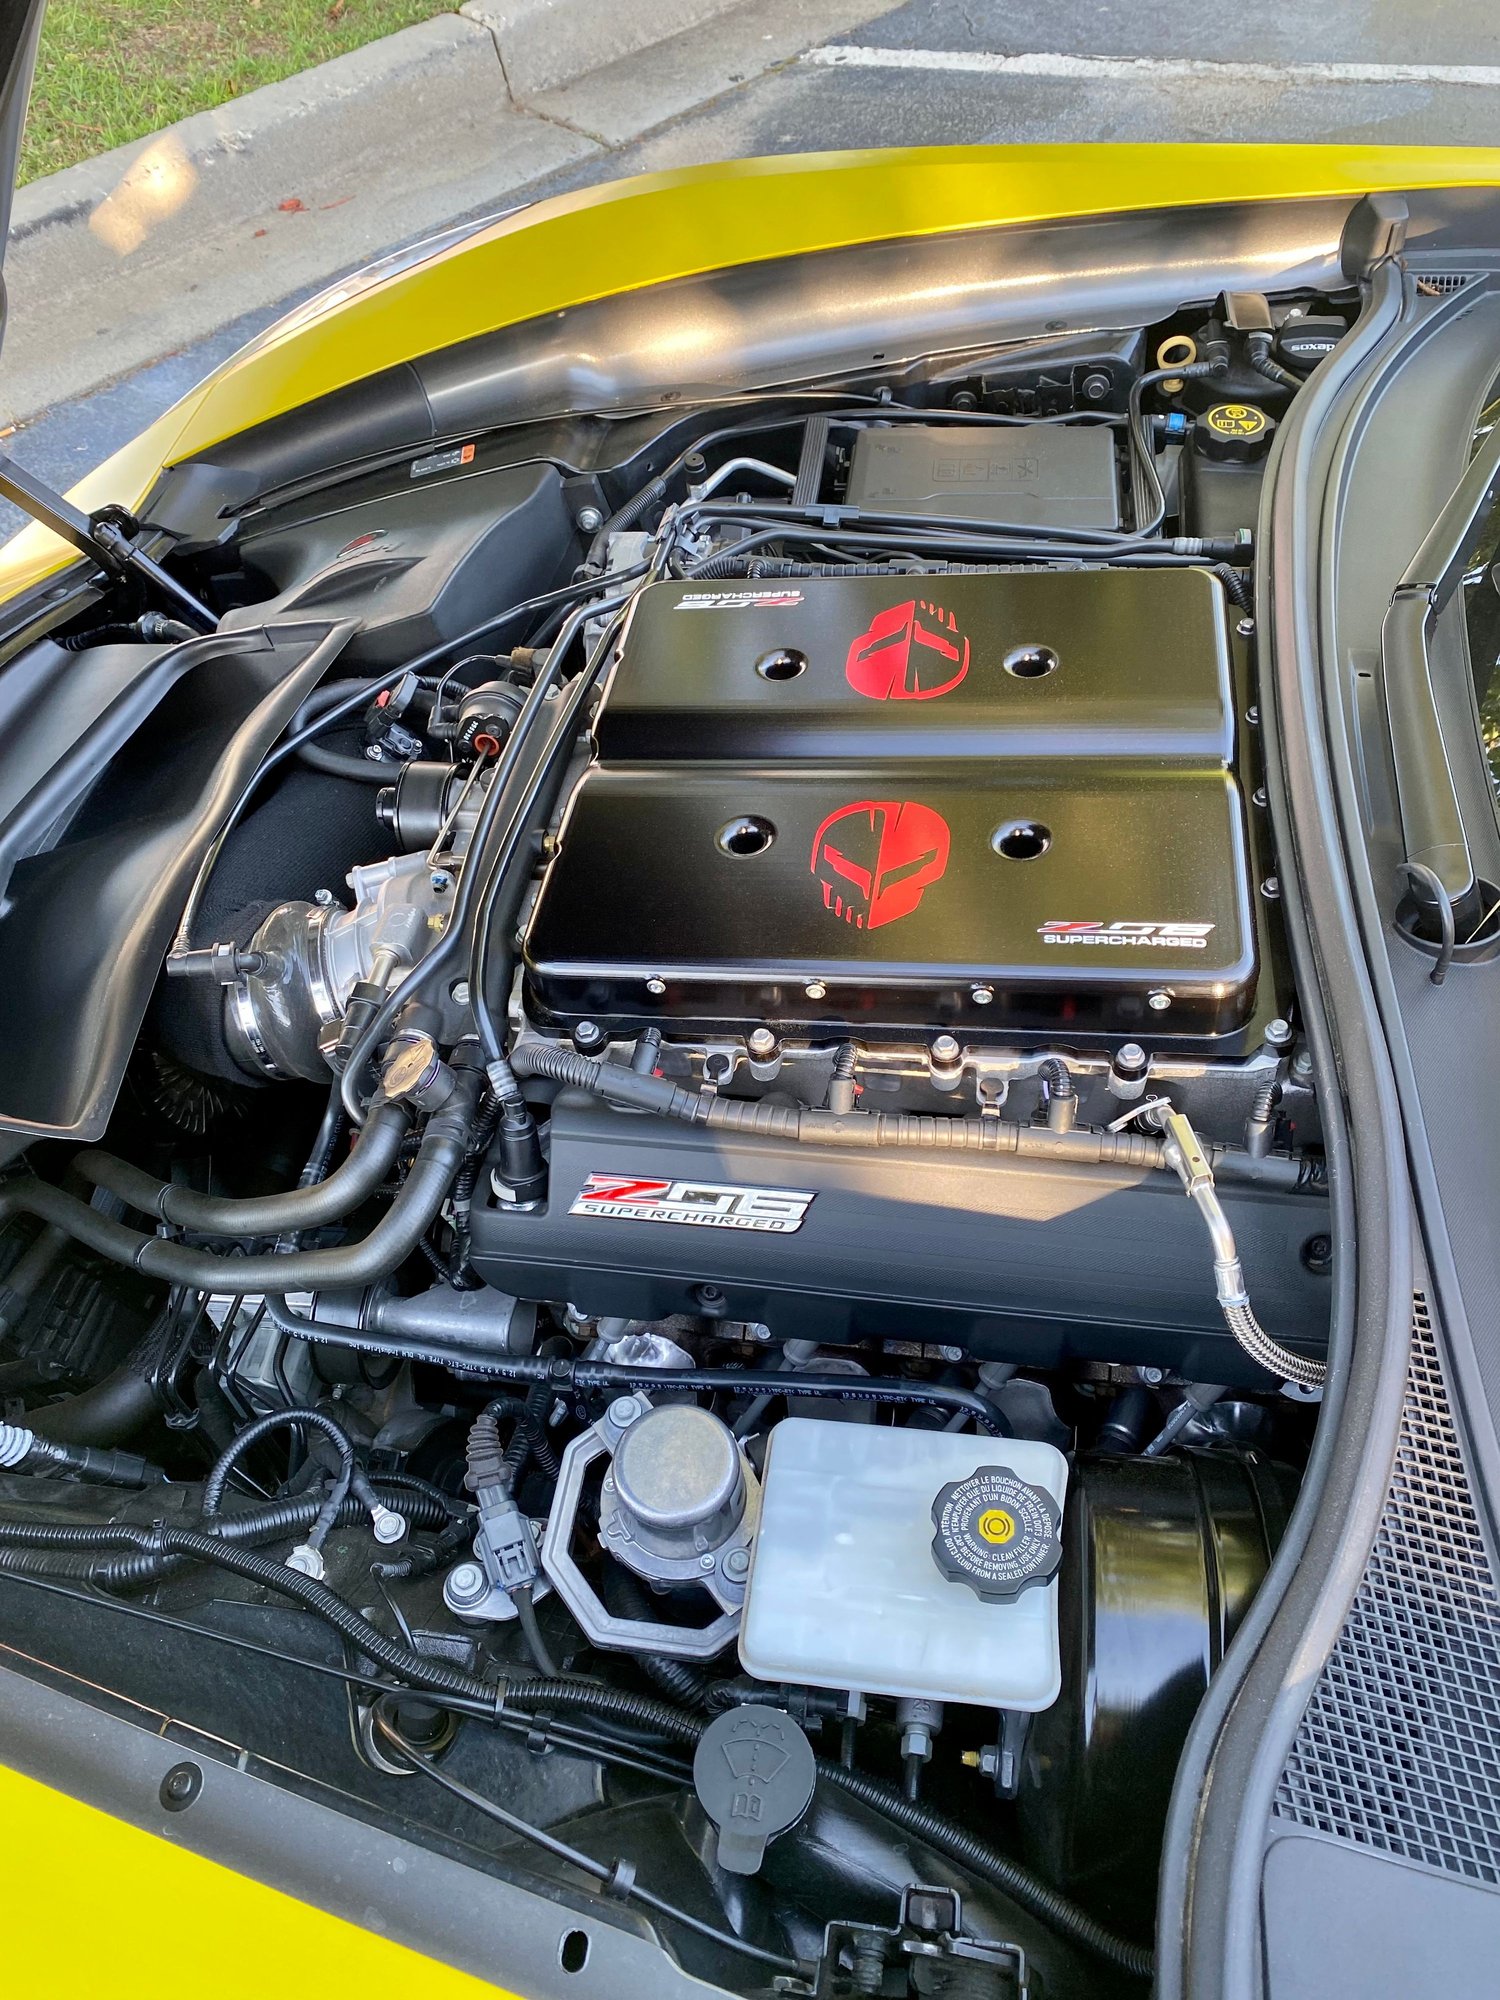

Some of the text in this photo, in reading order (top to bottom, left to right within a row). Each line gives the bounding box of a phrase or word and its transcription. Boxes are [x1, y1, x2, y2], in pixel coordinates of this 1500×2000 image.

[1291, 343, 1336, 352] dexos
[673, 598, 805, 609] Z06
[683, 591, 800, 600] SUPERCHARGED
[1037, 921, 1216, 936] Z06
[1043, 935, 1208, 949] SUPERCHARGED
[580, 1176, 817, 1219] Z06
[584, 1204, 786, 1231] SUPERCHARGED
[941, 1501, 954, 1536] ATTENTION
[950, 1478, 981, 1501] NETTOYER
[980, 1476, 990, 1485] LE
[991, 1475, 1023, 1490] BOUCHON
[1020, 1486, 1041, 1504] AVANT
[1036, 1503, 1047, 1514] LA
[960, 1496, 982, 1531] PROVENANT
[982, 1493, 999, 1502] D'UN
[1000, 1494, 1022, 1510] BIDON
[966, 1487, 981, 1499] QUE
[980, 1484, 990, 1493] DU
[991, 1484, 1018, 1497] LIQUIDE
[1016, 1492, 1027, 1503] DE
[1023, 1500, 1040, 1520] FREIN
[1033, 1519, 1043, 1537] DOT3
[944, 1537, 1051, 1581] DOT3 FLUID FROM A SEALED CONTAINER.
[953, 1534, 1041, 1571] CAP BEFORE REMOVING. USE ONLY
[963, 1532, 1032, 1562] WARNING: CLEAN FILLER
